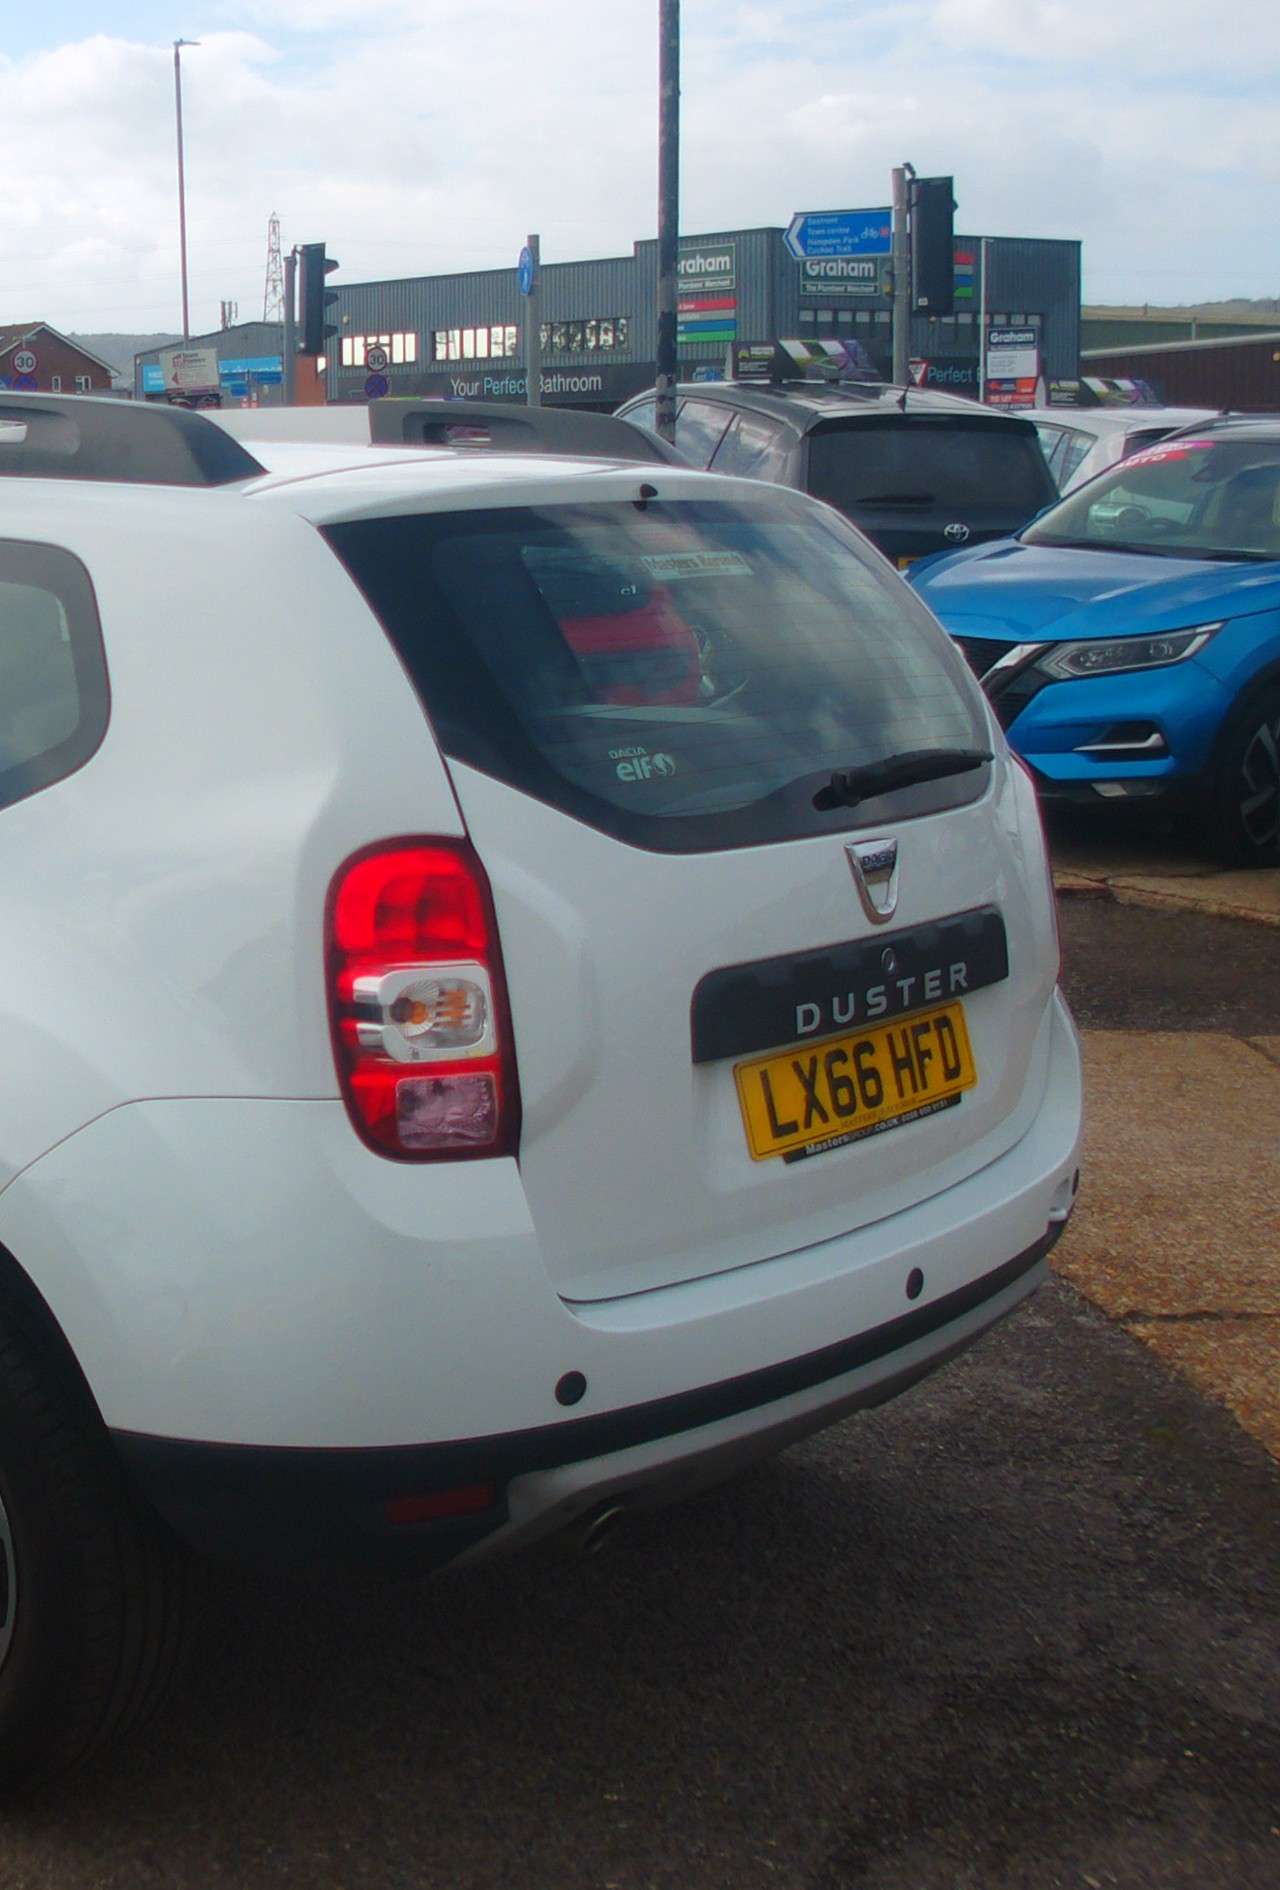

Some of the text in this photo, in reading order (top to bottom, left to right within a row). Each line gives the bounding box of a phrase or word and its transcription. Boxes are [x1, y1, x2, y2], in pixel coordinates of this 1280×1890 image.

[677, 254, 731, 274] raham
[806, 259, 875, 277] Graham
[990, 331, 1034, 343] Graham
[17, 356, 34, 368] 30
[370, 354, 384, 365] 30
[928, 366, 973, 383] Perfect
[451, 378, 480, 397] Your
[483, 375, 528, 396] Perfect
[796, 961, 969, 1035] DUSTER
[759, 1013, 962, 1140] LX66 HFD
